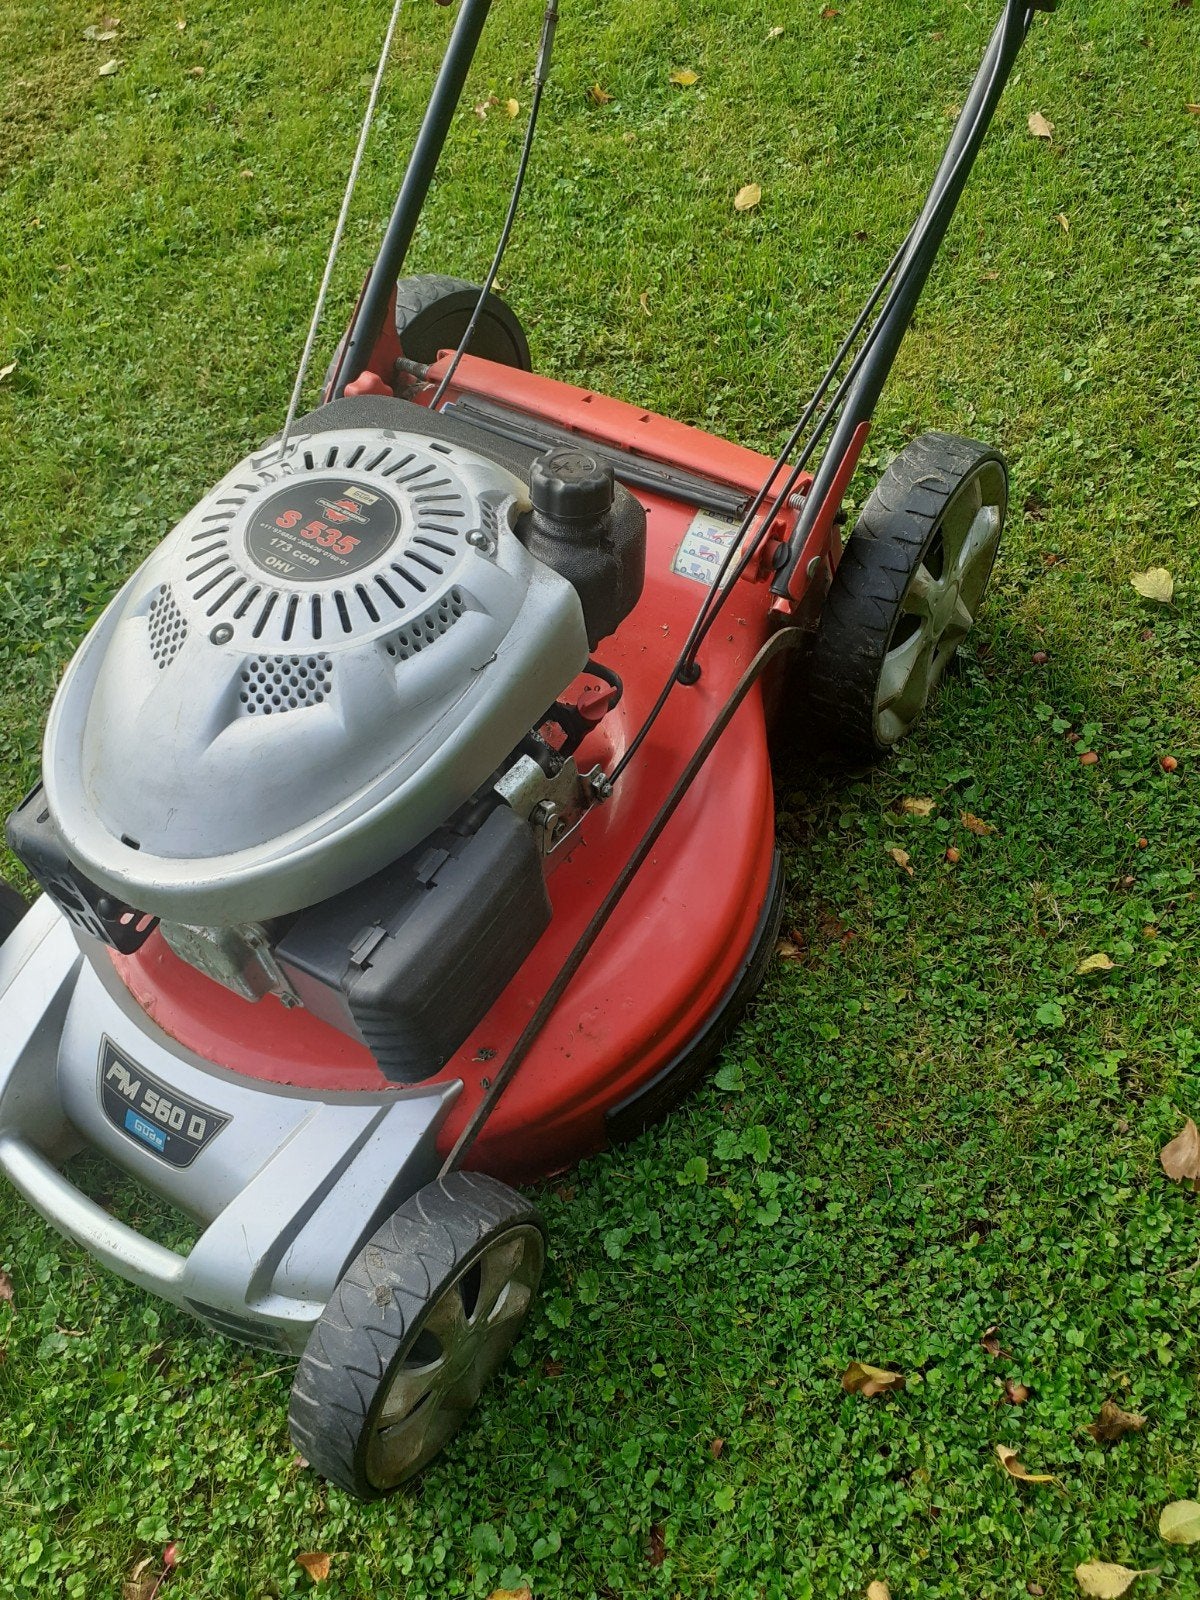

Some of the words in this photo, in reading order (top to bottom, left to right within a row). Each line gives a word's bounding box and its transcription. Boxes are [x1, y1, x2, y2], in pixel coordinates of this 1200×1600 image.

[275, 509, 303, 528] S
[300, 520, 361, 555] 535
[264, 555, 296, 574] OHV
[269, 537, 294, 552] 173
[291, 550, 321, 567] ccm
[106, 1060, 141, 1101] PM
[140, 1088, 186, 1131] 560
